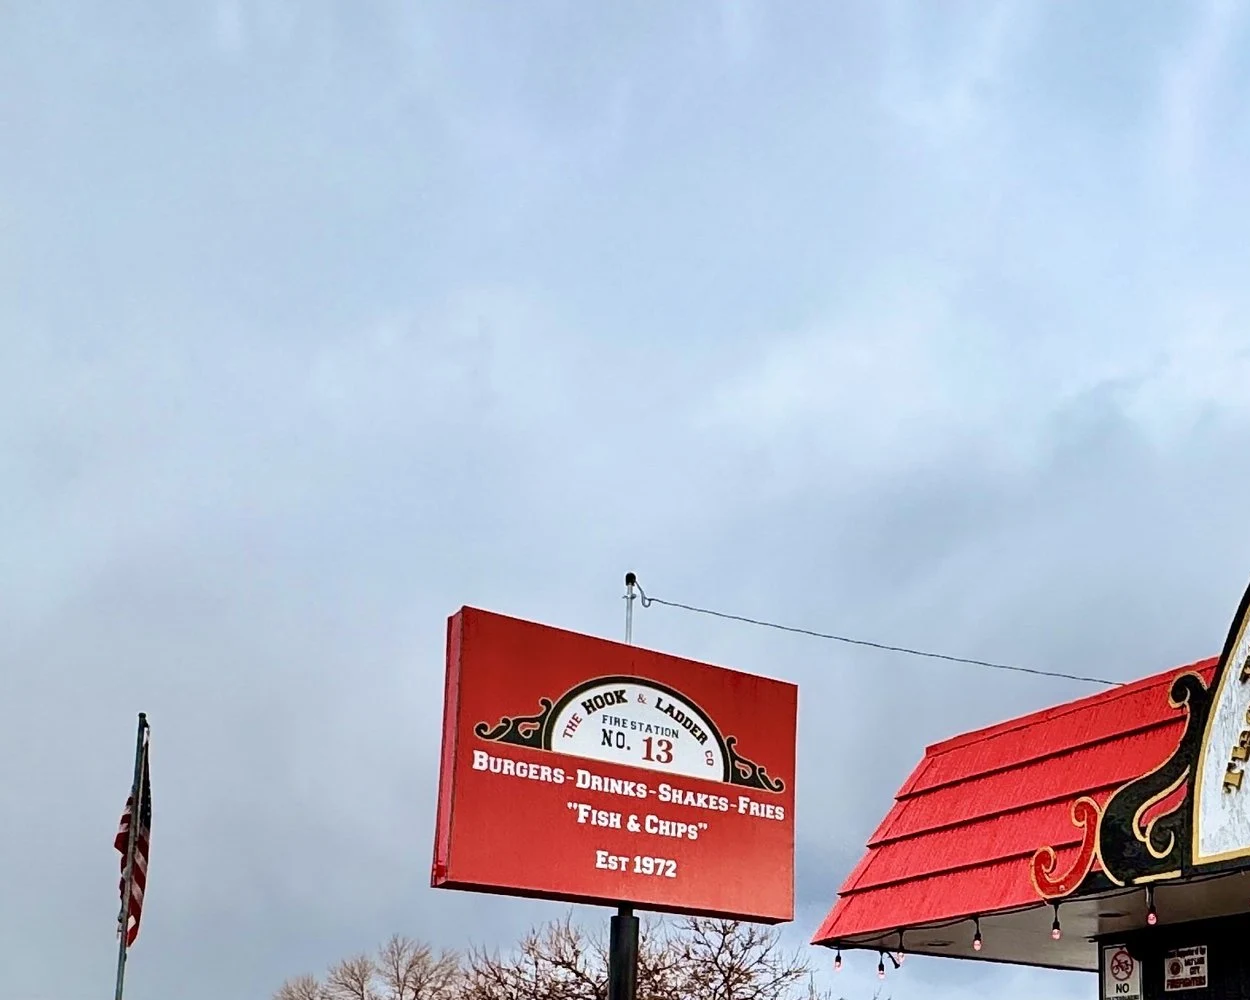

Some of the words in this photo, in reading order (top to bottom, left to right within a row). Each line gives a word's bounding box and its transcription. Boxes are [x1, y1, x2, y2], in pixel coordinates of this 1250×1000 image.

[562, 712, 583, 739] THE
[581, 689, 628, 715] HOOK
[637, 693, 647, 704] &
[655, 697, 709, 746] LADDER
[602, 714, 629, 729] FIRE
[630, 720, 680, 739] STATION
[601, 728, 631, 751] NO.
[642, 736, 674, 764] 13
[626, 814, 641, 832] &
[633, 855, 678, 878] 1972
[1115, 983, 1130, 993] NO
